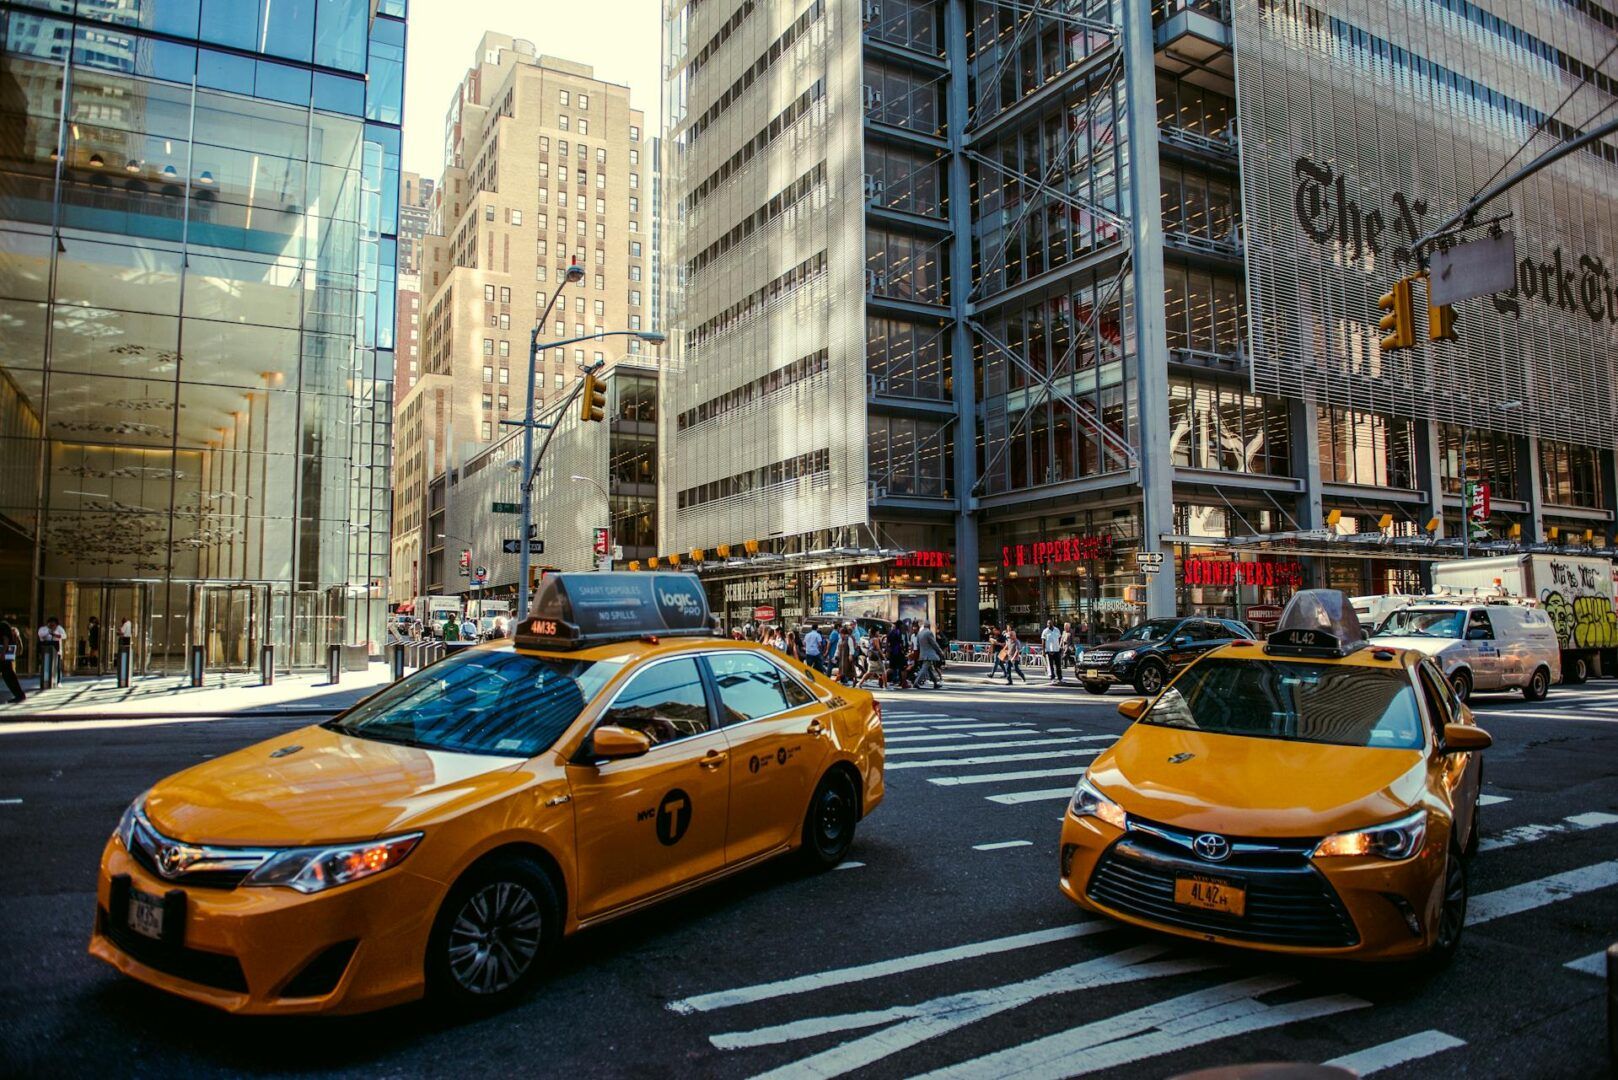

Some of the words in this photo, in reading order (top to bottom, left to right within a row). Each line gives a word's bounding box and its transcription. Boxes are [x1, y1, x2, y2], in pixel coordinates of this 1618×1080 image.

[1295, 157, 1384, 263] The
[1472, 484, 1485, 519] ART
[579, 587, 604, 595] SMART
[599, 611, 609, 620] NO
[683, 606, 701, 617] PRO
[530, 621, 557, 635] 4M35
[1289, 631, 1315, 645] 4L42
[637, 808, 656, 822] NYC
